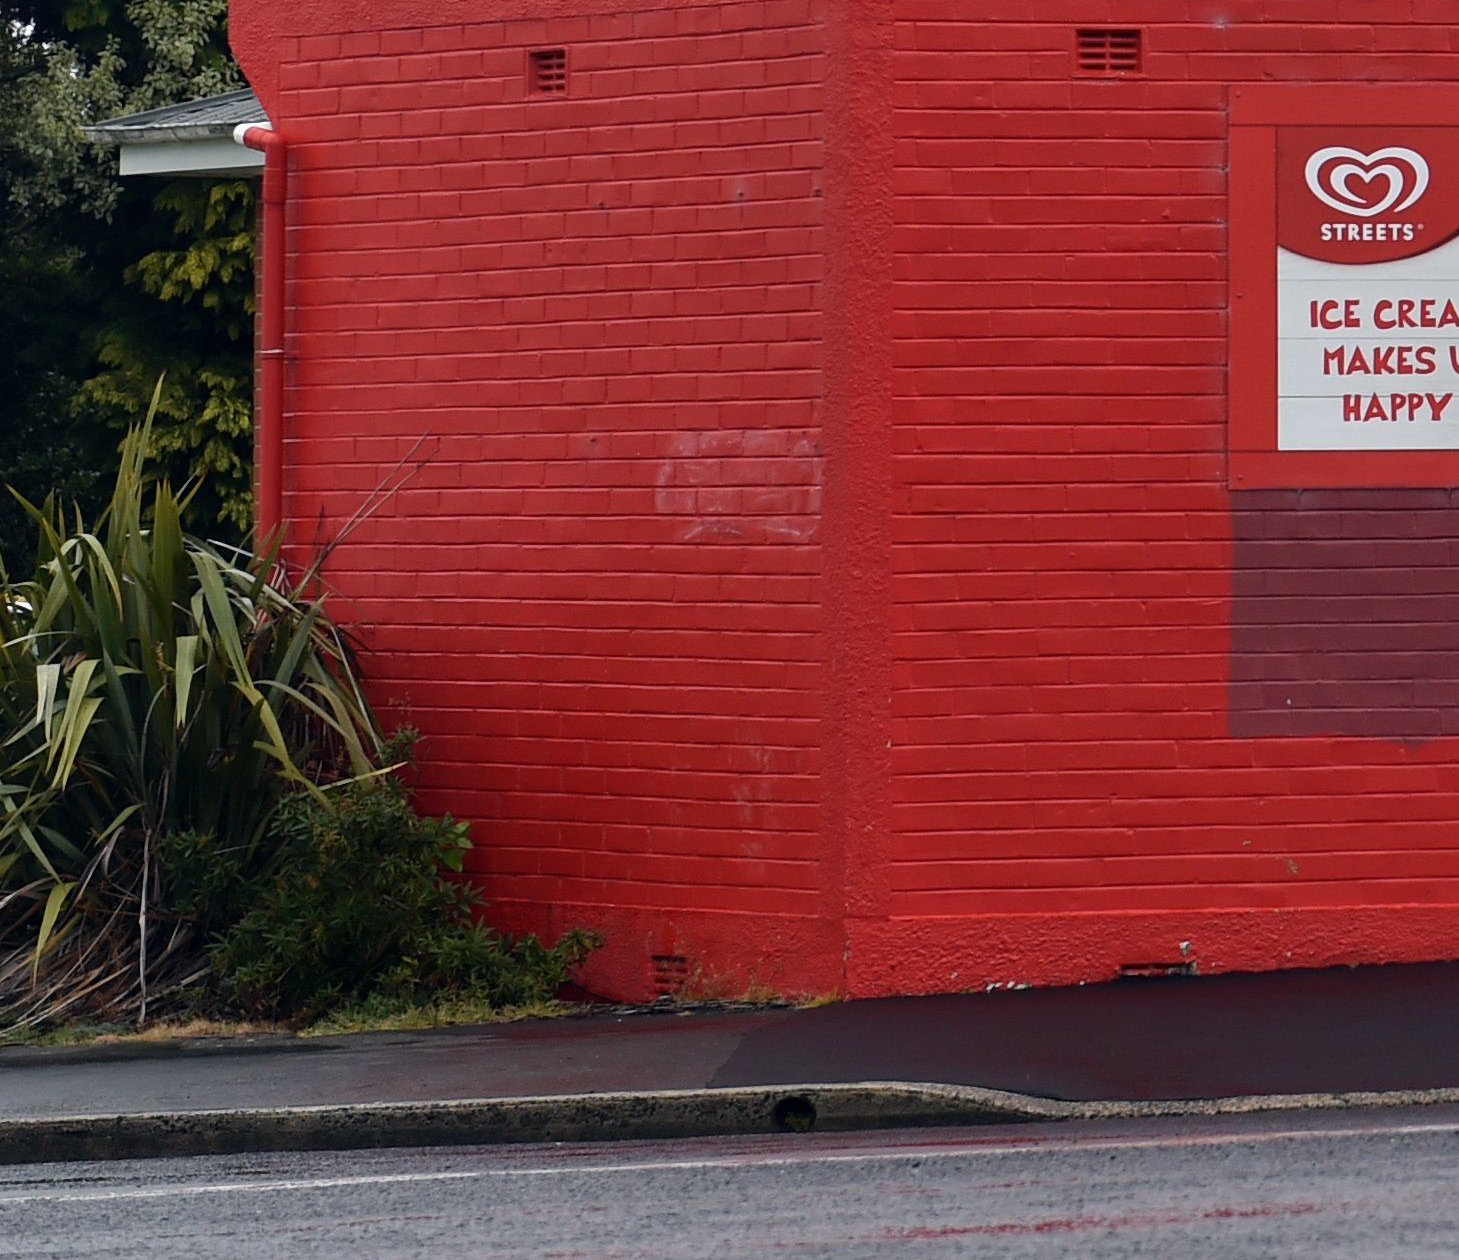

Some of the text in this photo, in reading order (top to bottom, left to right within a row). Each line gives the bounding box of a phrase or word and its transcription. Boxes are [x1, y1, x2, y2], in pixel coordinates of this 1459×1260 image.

[1320, 223, 1414, 241] STREETS
[1310, 298, 1361, 330] ICE
[1323, 345, 1437, 376] MAKES
[1342, 392, 1454, 423] HAPPY
